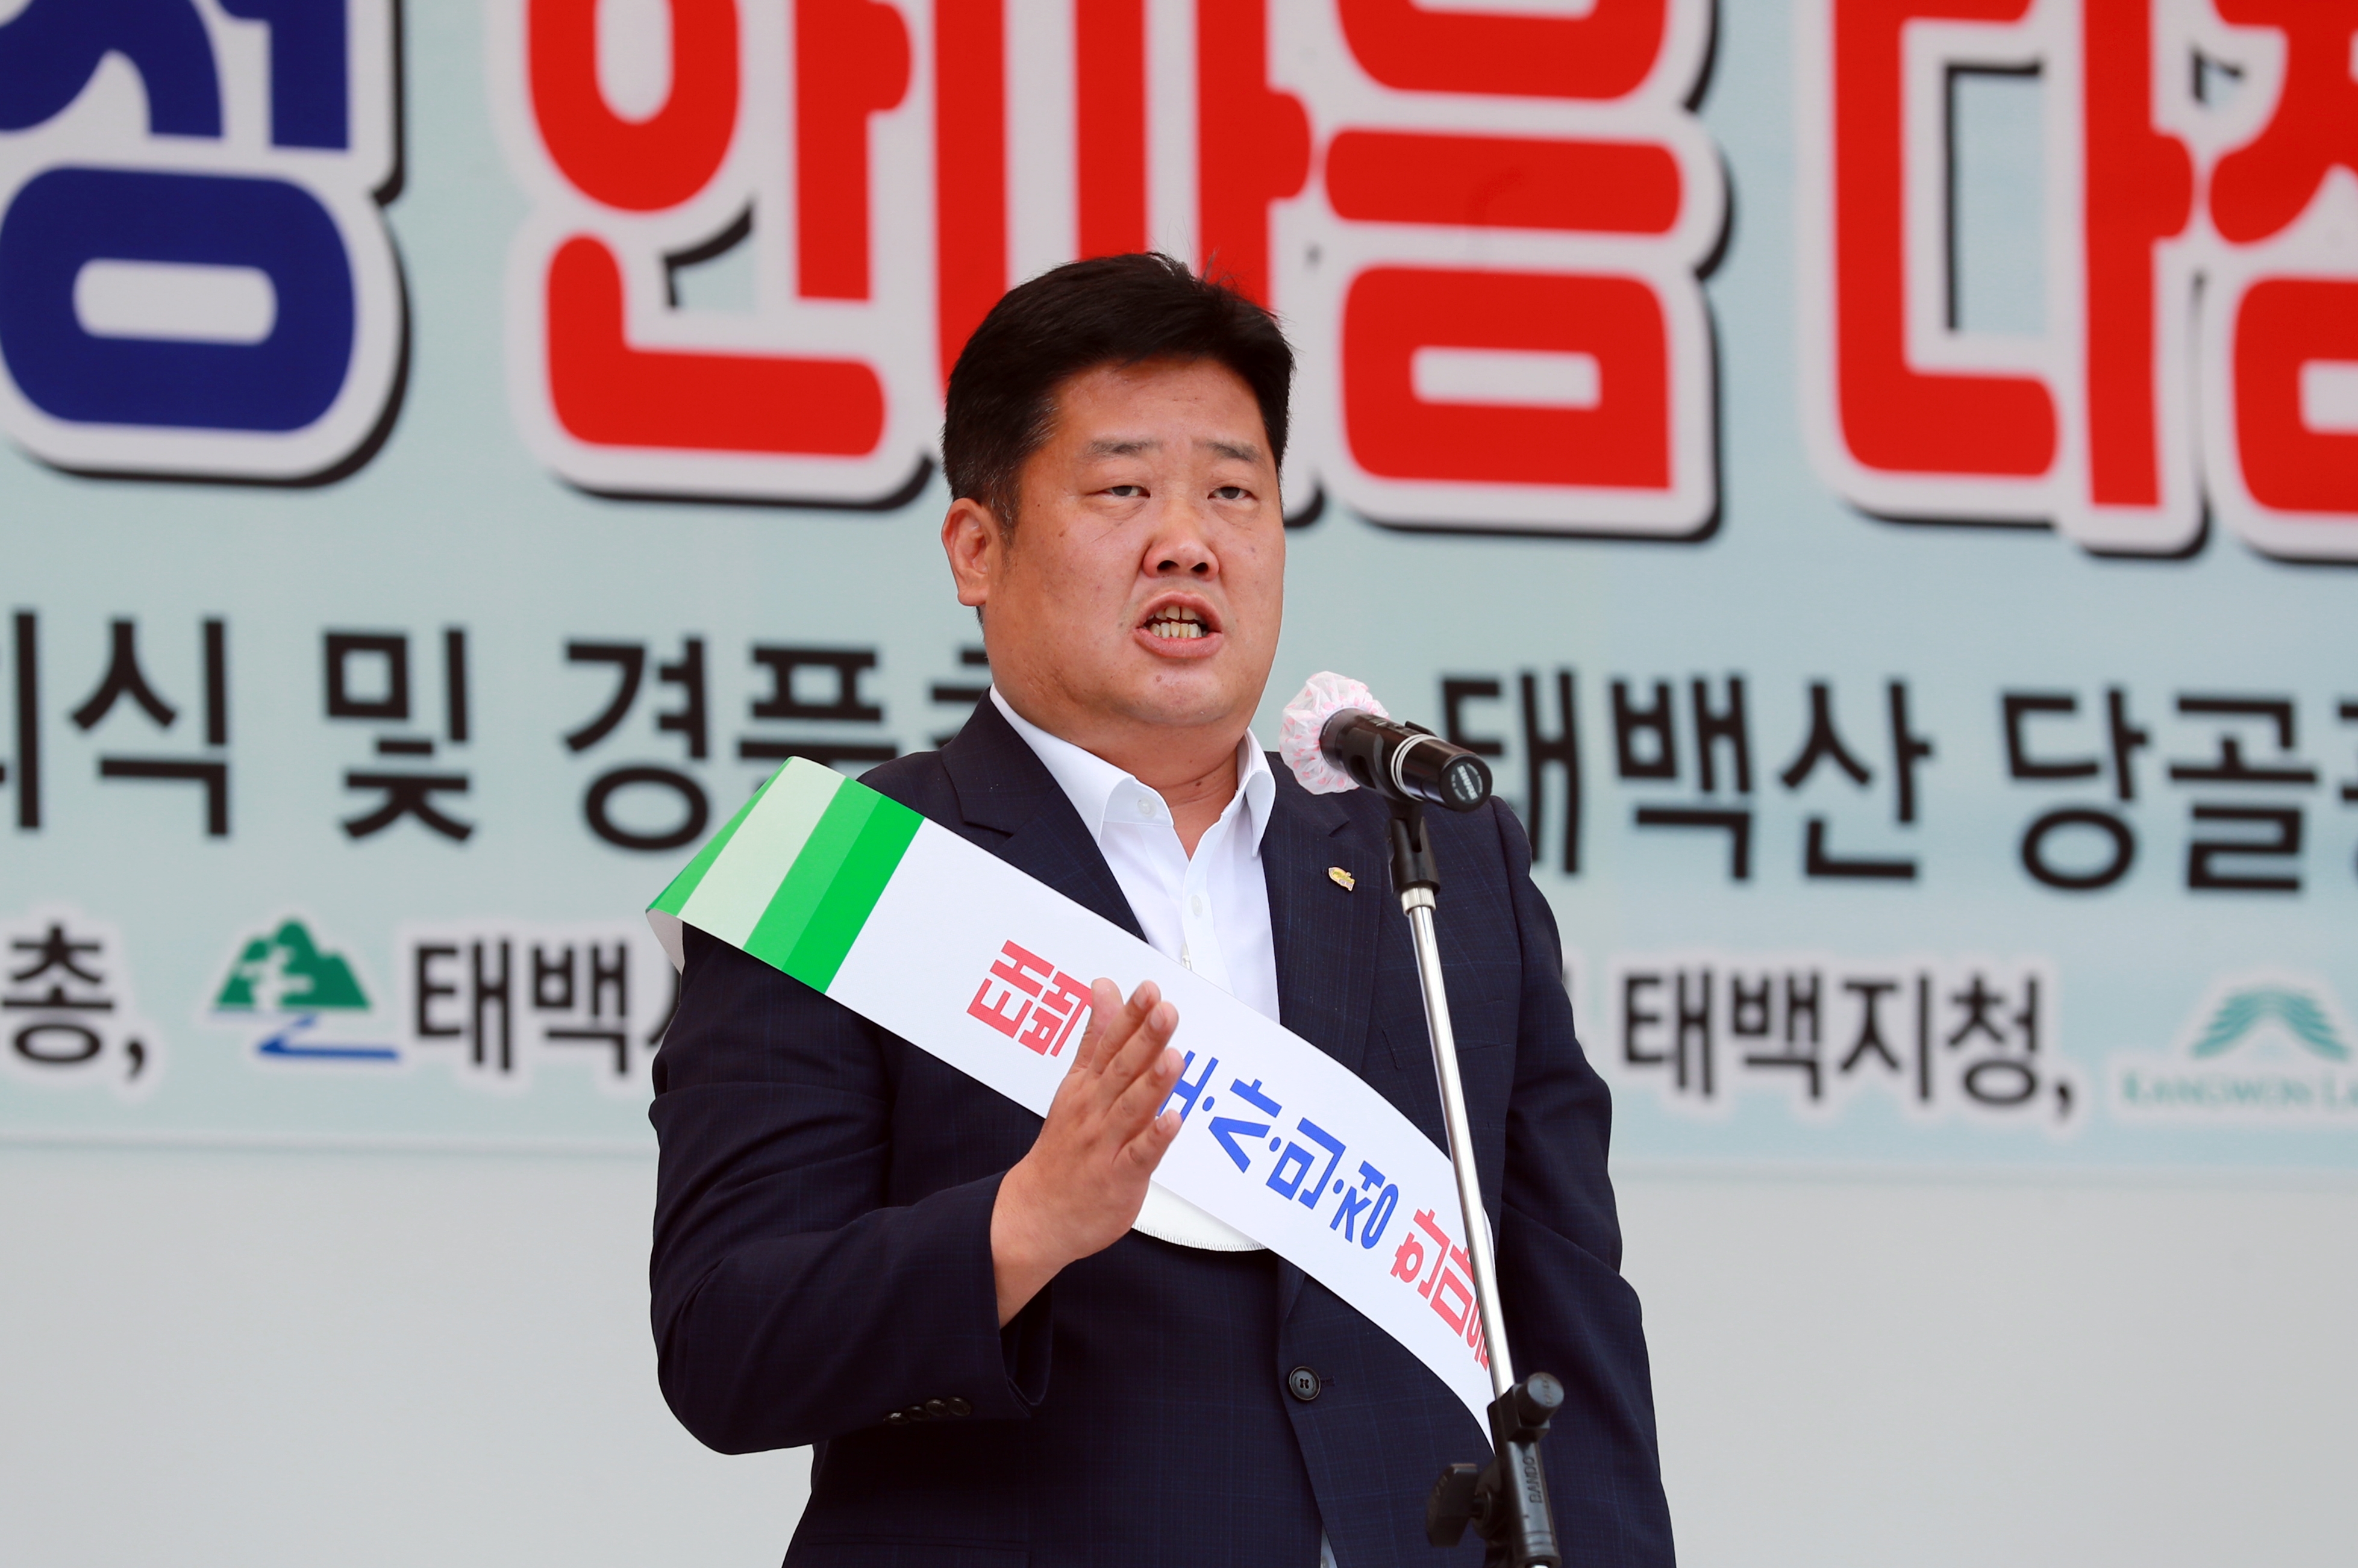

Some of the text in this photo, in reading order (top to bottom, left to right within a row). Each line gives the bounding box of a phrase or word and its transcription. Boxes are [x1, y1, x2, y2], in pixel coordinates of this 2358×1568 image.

[322, 627, 474, 843] 및
[2000, 687, 2358, 894] 당골
[1457, 765, 1478, 800] SHURE
[1624, 971, 2072, 1114] 태백지청,
[1522, 1456, 1544, 1504] BANDO
